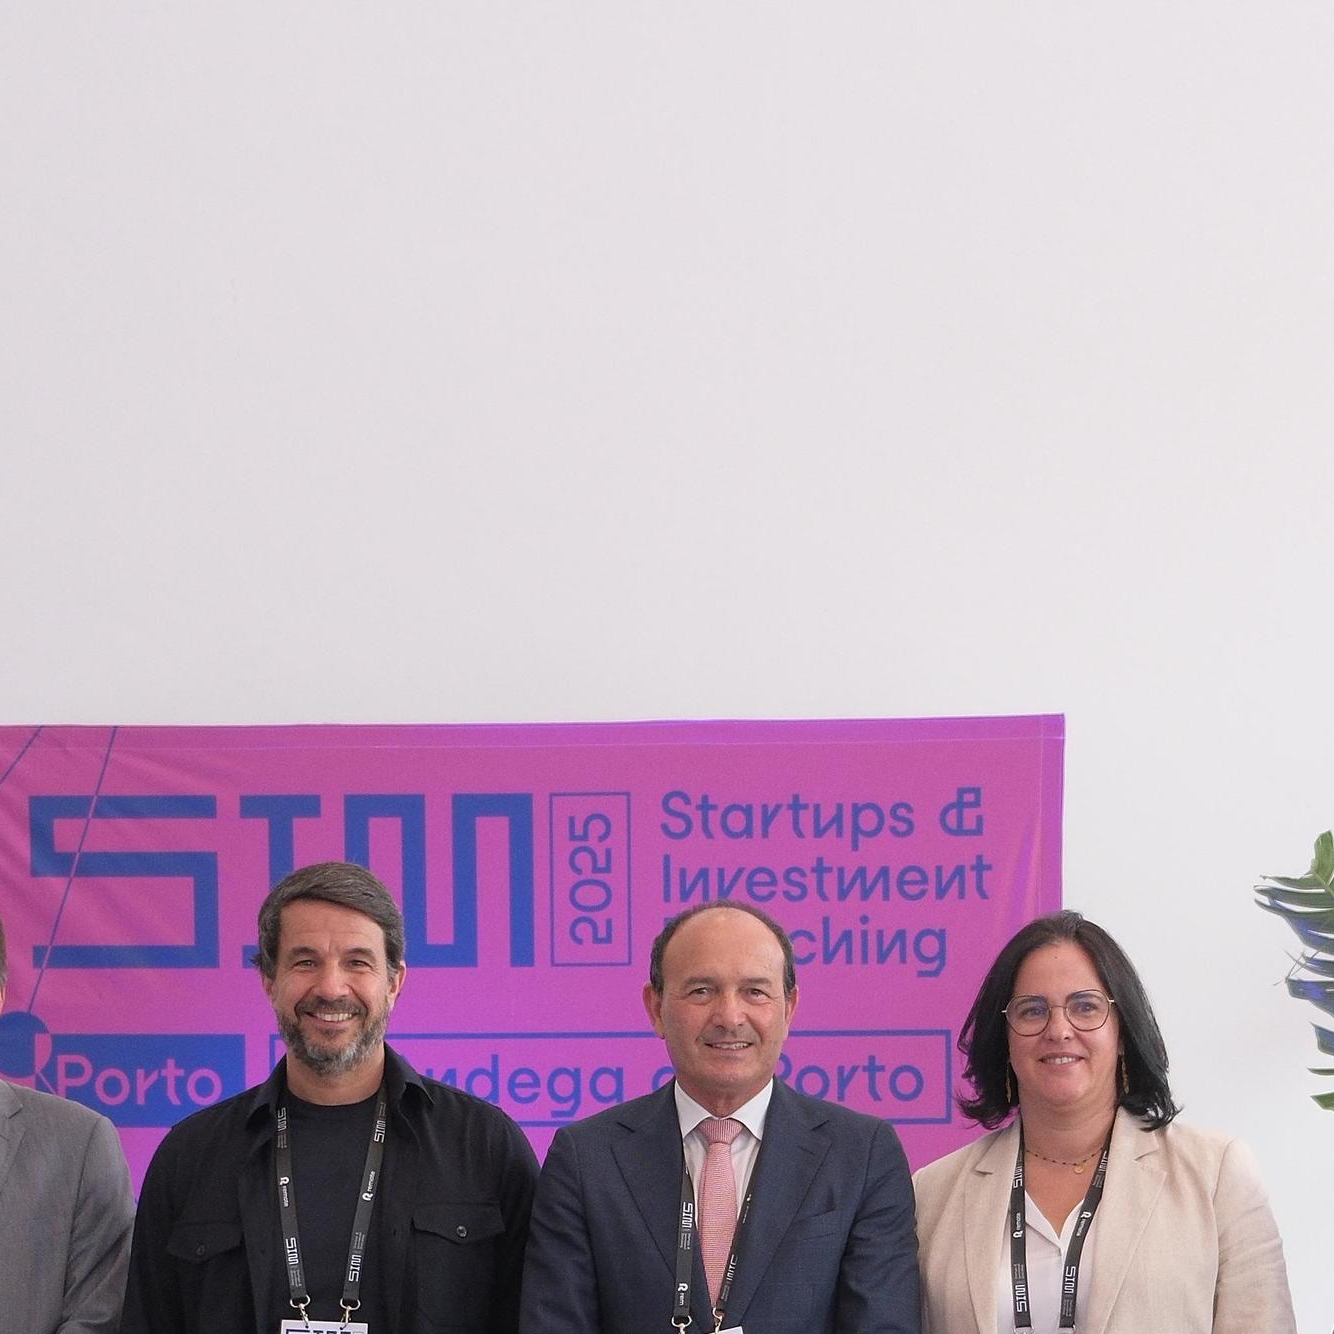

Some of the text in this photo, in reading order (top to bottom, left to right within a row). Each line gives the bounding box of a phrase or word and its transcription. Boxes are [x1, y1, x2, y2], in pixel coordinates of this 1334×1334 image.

[660, 790, 916, 851] Startups
[30, 793, 533, 968] SIM
[569, 812, 613, 946] 2025
[663, 853, 994, 902] Investment
[56, 1054, 223, 1107] Porto
[277, 1107, 286, 1131] SIM
[374, 1120, 386, 1143] SIM
[681, 1202, 693, 1229] SIM
[285, 1237, 299, 1265] SIM
[348, 1254, 362, 1282] SIM
[1064, 1266, 1077, 1294] SIM
[1015, 1284, 1027, 1313] SIM
